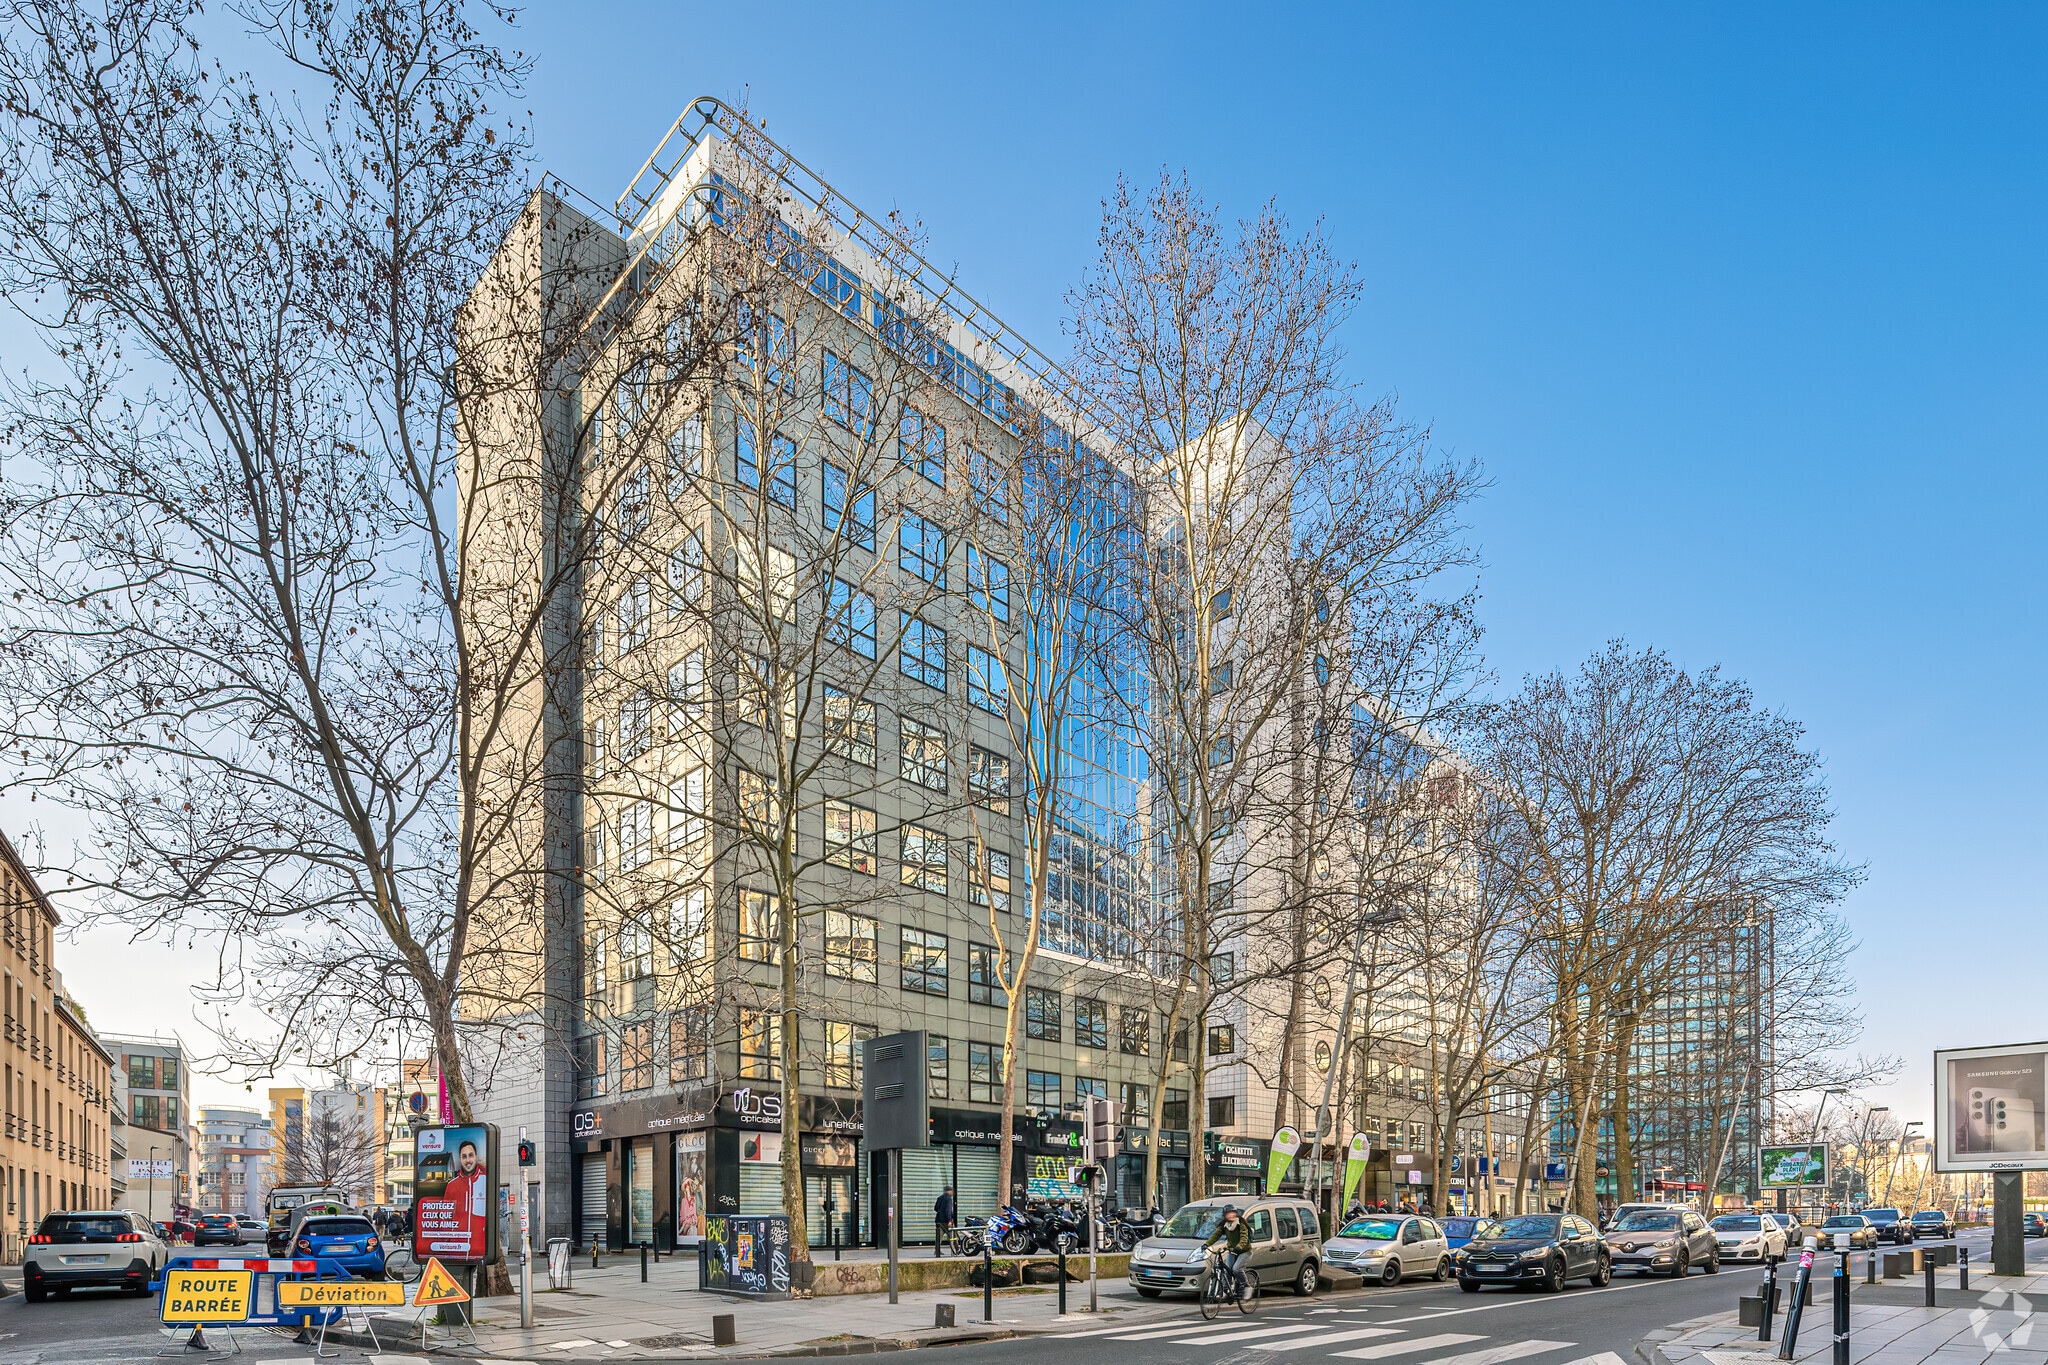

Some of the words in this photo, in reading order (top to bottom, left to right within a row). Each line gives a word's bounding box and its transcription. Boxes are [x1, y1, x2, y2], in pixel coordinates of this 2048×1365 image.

[648, 1118, 671, 1129] optique
[741, 1115, 781, 1124] opticalser
[955, 1130, 984, 1139] optique
[987, 1131, 1023, 1142] méale
[1226, 1146, 1253, 1155] CIGARETTE
[1222, 1154, 1257, 1167] ÉLECTRONIQUE
[422, 1201, 455, 1210] PROTÉGEZ
[422, 1211, 439, 1219] CEUX
[439, 1211, 452, 1220] QUE
[421, 1220, 438, 1229] VOUS
[439, 1220, 459, 1229] AIMEZ
[180, 1279, 238, 1292] ROUTE
[300, 1286, 387, 1301] Déviation
[171, 1297, 242, 1312] BARRÉE
